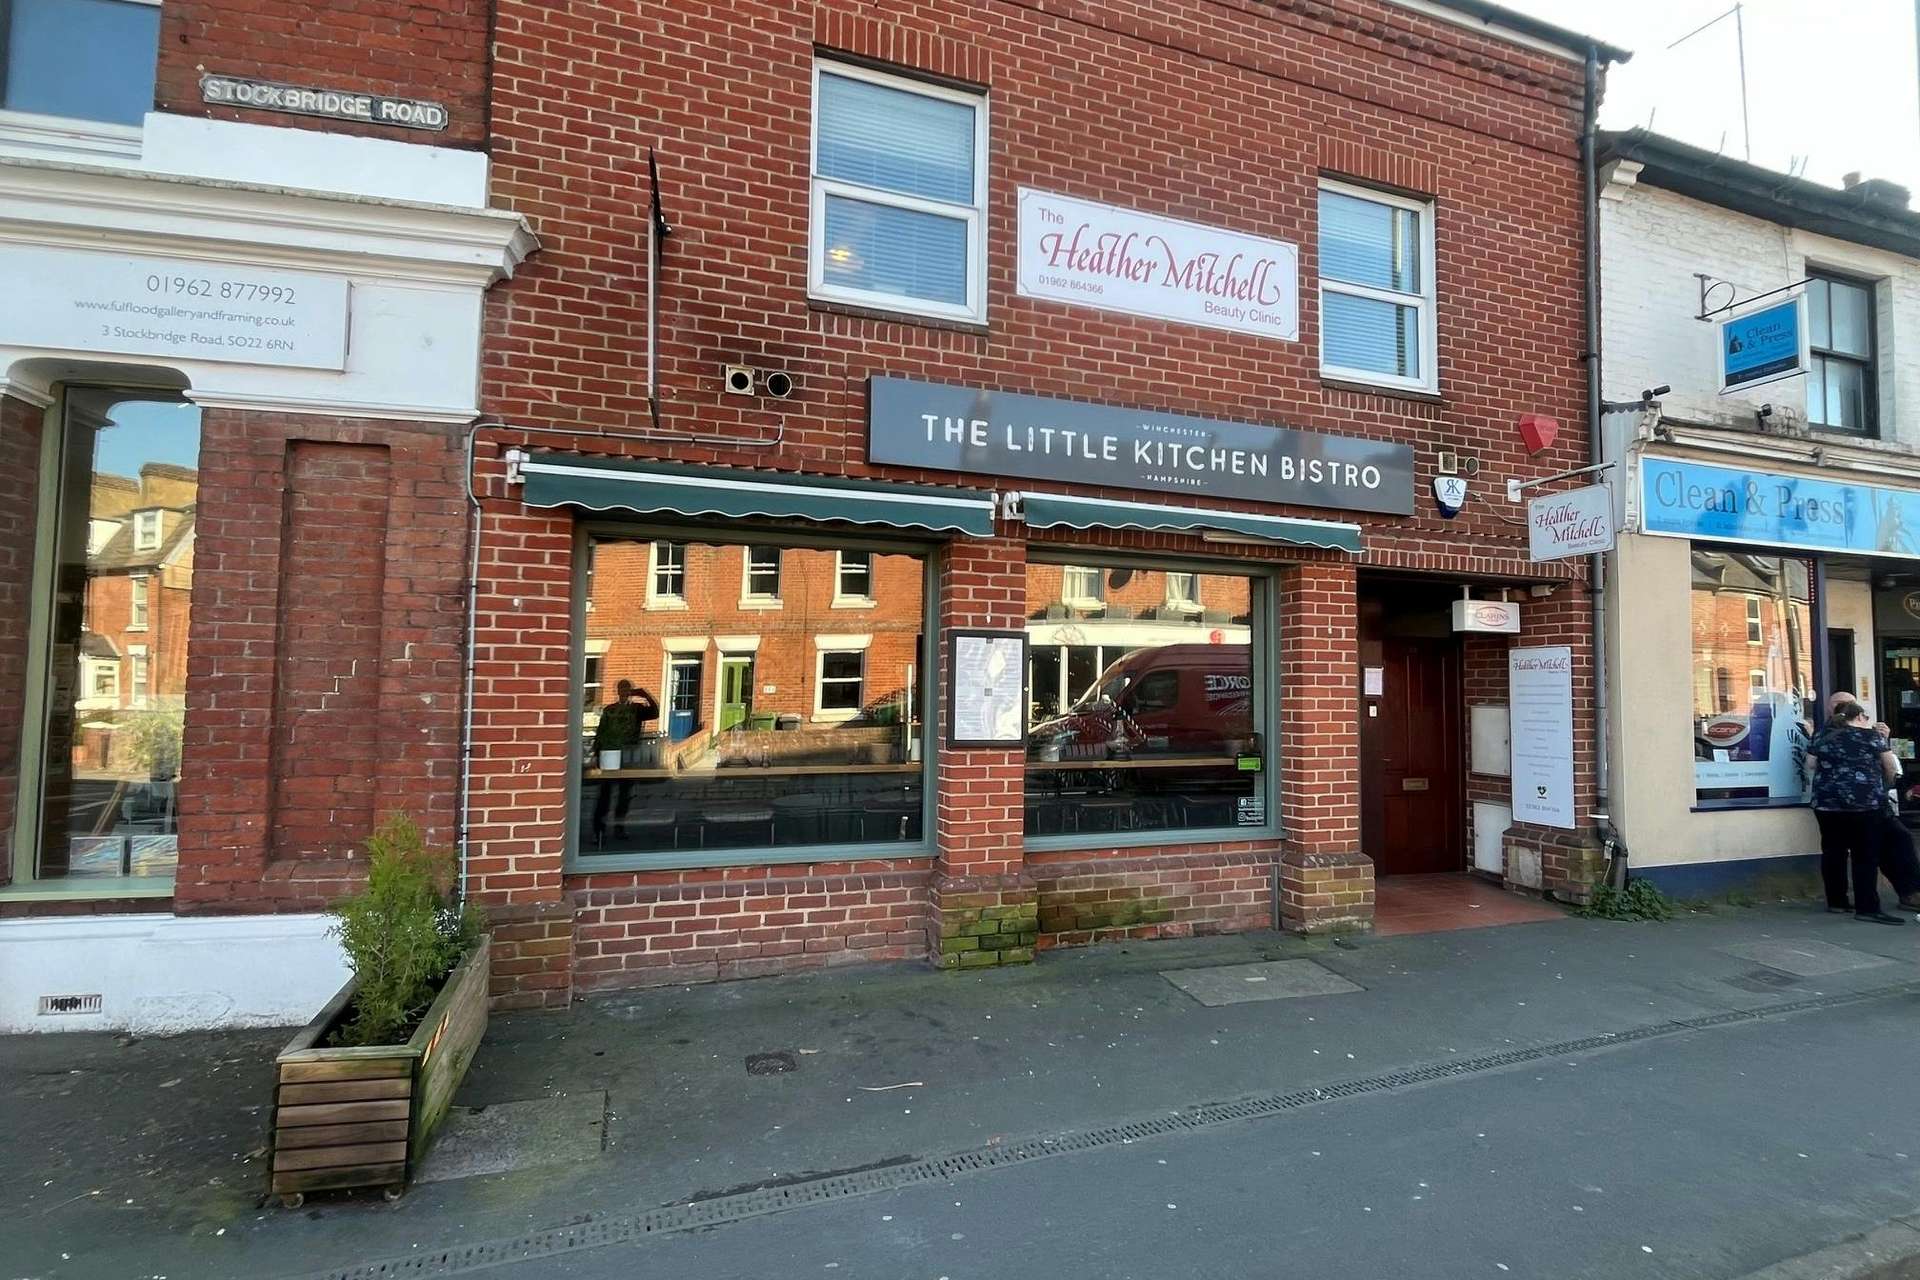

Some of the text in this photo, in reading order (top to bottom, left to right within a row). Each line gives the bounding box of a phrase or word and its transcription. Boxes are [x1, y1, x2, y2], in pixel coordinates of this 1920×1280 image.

[205, 80, 442, 125] STOCKBRIDGE ROAD
[1038, 207, 1064, 225] The
[1040, 223, 1280, 306] Heather Mitchell
[147, 275, 296, 304] 01962 877992
[74, 299, 295, 327] www.fulfloodgalleryandframing.co.uk
[1205, 300, 1281, 325] Beauty Clinic
[102, 325, 109, 337] 3
[114, 326, 186, 345] Stockbridge
[228, 336, 262, 349] SO22
[266, 339, 294, 351] 6RN
[1746, 323, 1781, 338] Clean
[1760, 330, 1793, 345] Press
[1143, 423, 1206, 438] WINCHESTER
[921, 414, 1381, 489] THE LITTLE KITCHEN BISTRO
[1146, 474, 1202, 487] HAMPSHIRE
[1655, 471, 1845, 525] Clean & Press
[1536, 502, 1580, 528] Heather
[1545, 516, 1605, 544] Mitchell
